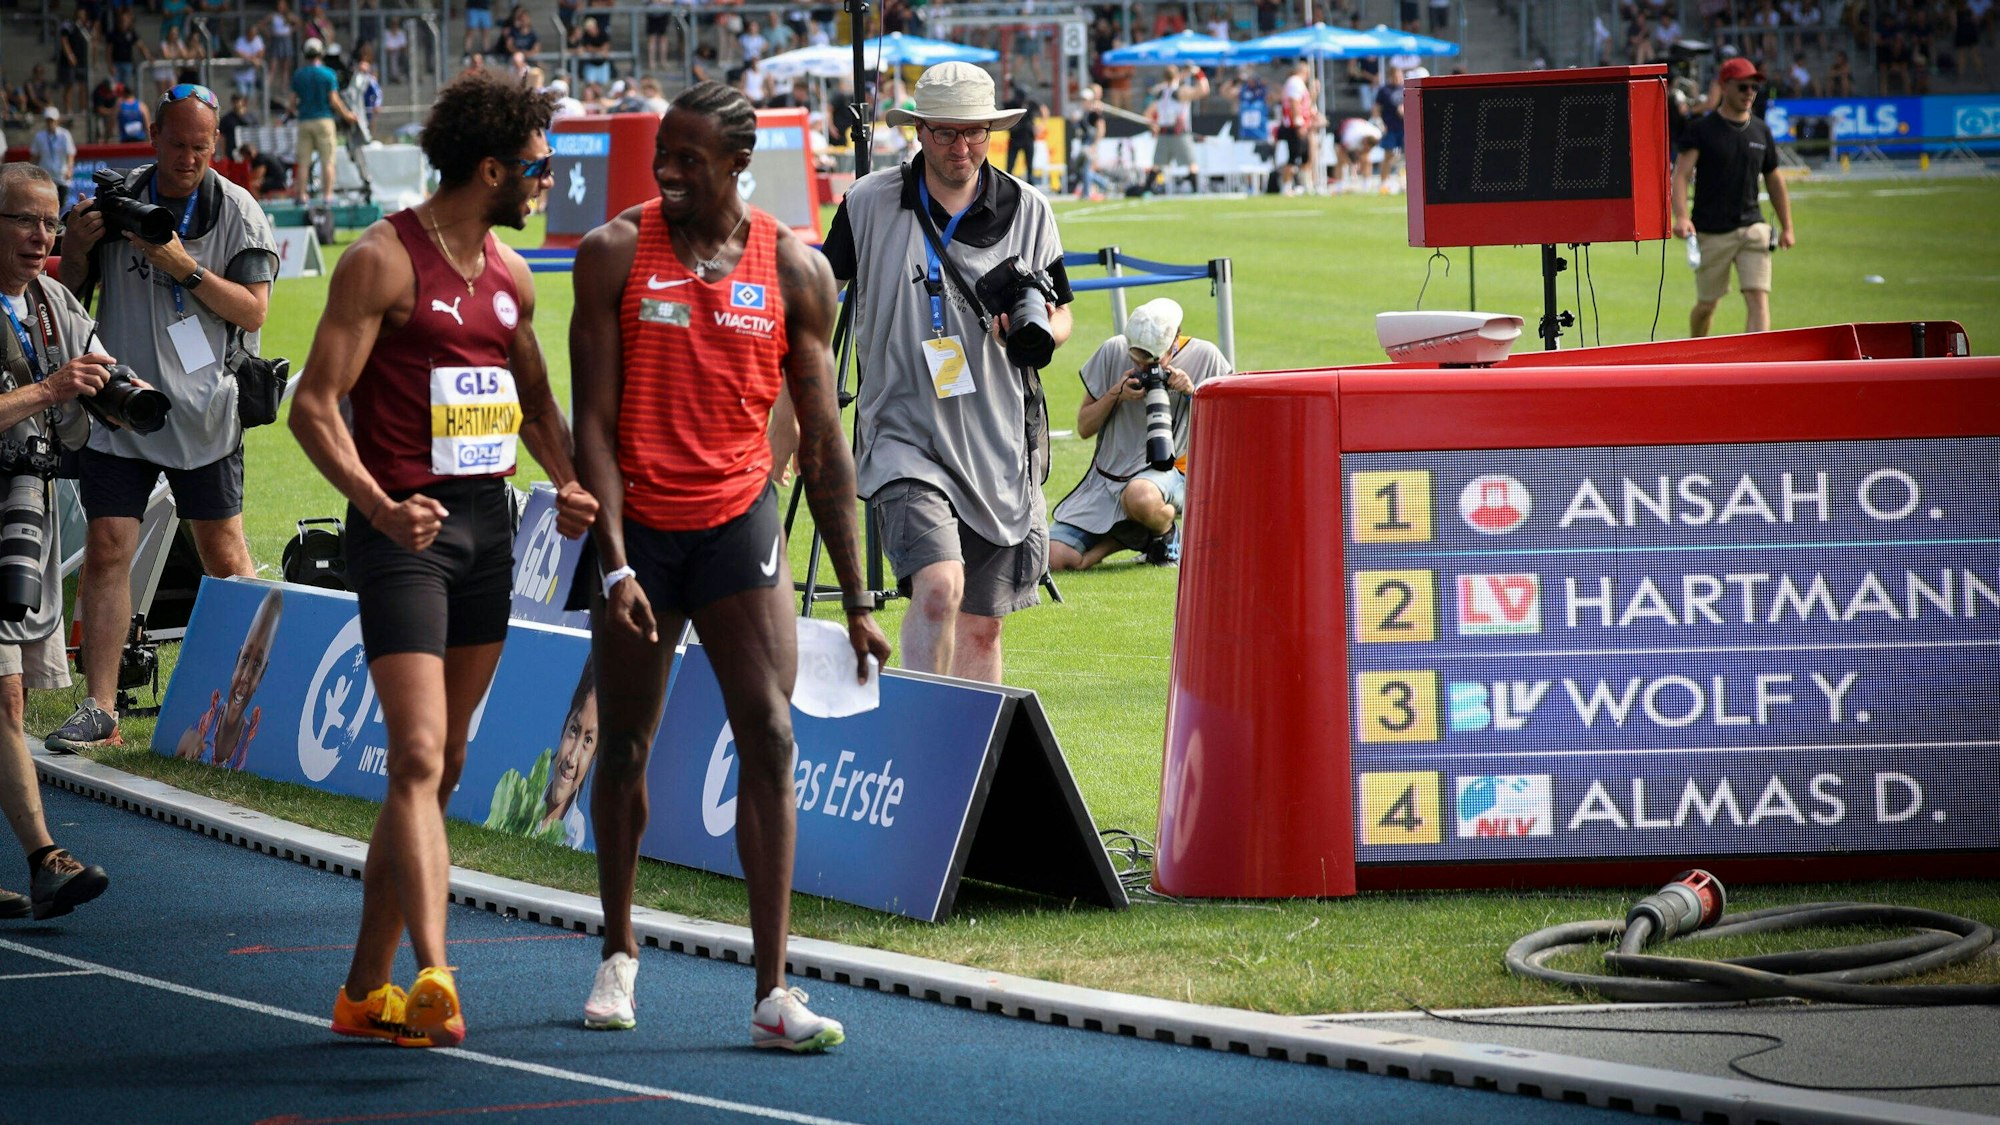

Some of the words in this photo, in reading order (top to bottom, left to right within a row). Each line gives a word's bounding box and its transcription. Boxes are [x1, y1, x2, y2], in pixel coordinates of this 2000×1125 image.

[38, 303, 53, 336] Canon
[714, 311, 776, 333] VIACTIV
[1374, 482, 1411, 530] 1
[1559, 472, 1828, 528] ANSAH
[1858, 467, 1944, 522] O.
[1374, 580, 1413, 631] 2
[1378, 681, 1414, 732] 3
[1563, 674, 1794, 729] WOLF
[1811, 672, 1871, 725] Y.
[823, 750, 905, 829] Erste
[1378, 785, 1424, 833] 4
[1568, 772, 1846, 831] ALMAS
[1876, 771, 1946, 824] D.
